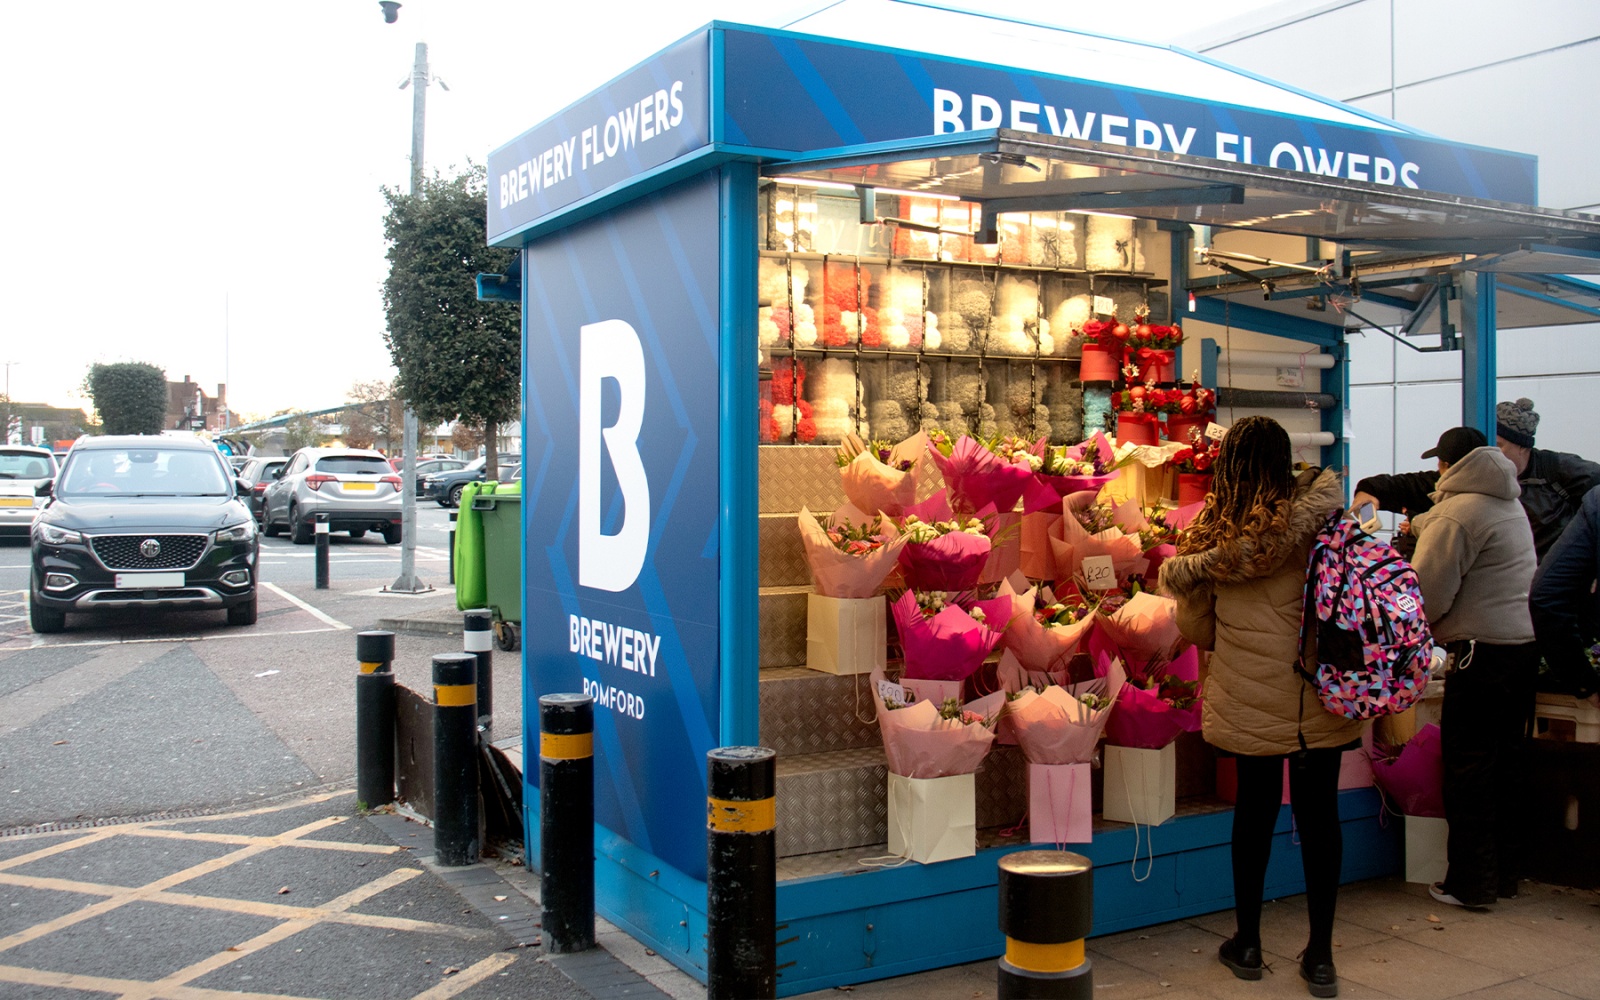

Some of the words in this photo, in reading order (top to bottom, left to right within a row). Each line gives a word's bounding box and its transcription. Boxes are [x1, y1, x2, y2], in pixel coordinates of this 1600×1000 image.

[500, 136, 576, 210] BREWERY
[582, 80, 683, 171] FLOWERS
[579, 319, 650, 592] B
[1086, 566, 1111, 583] £20
[569, 614, 661, 678] BREWERY
[583, 677, 645, 720] ROMFORD
